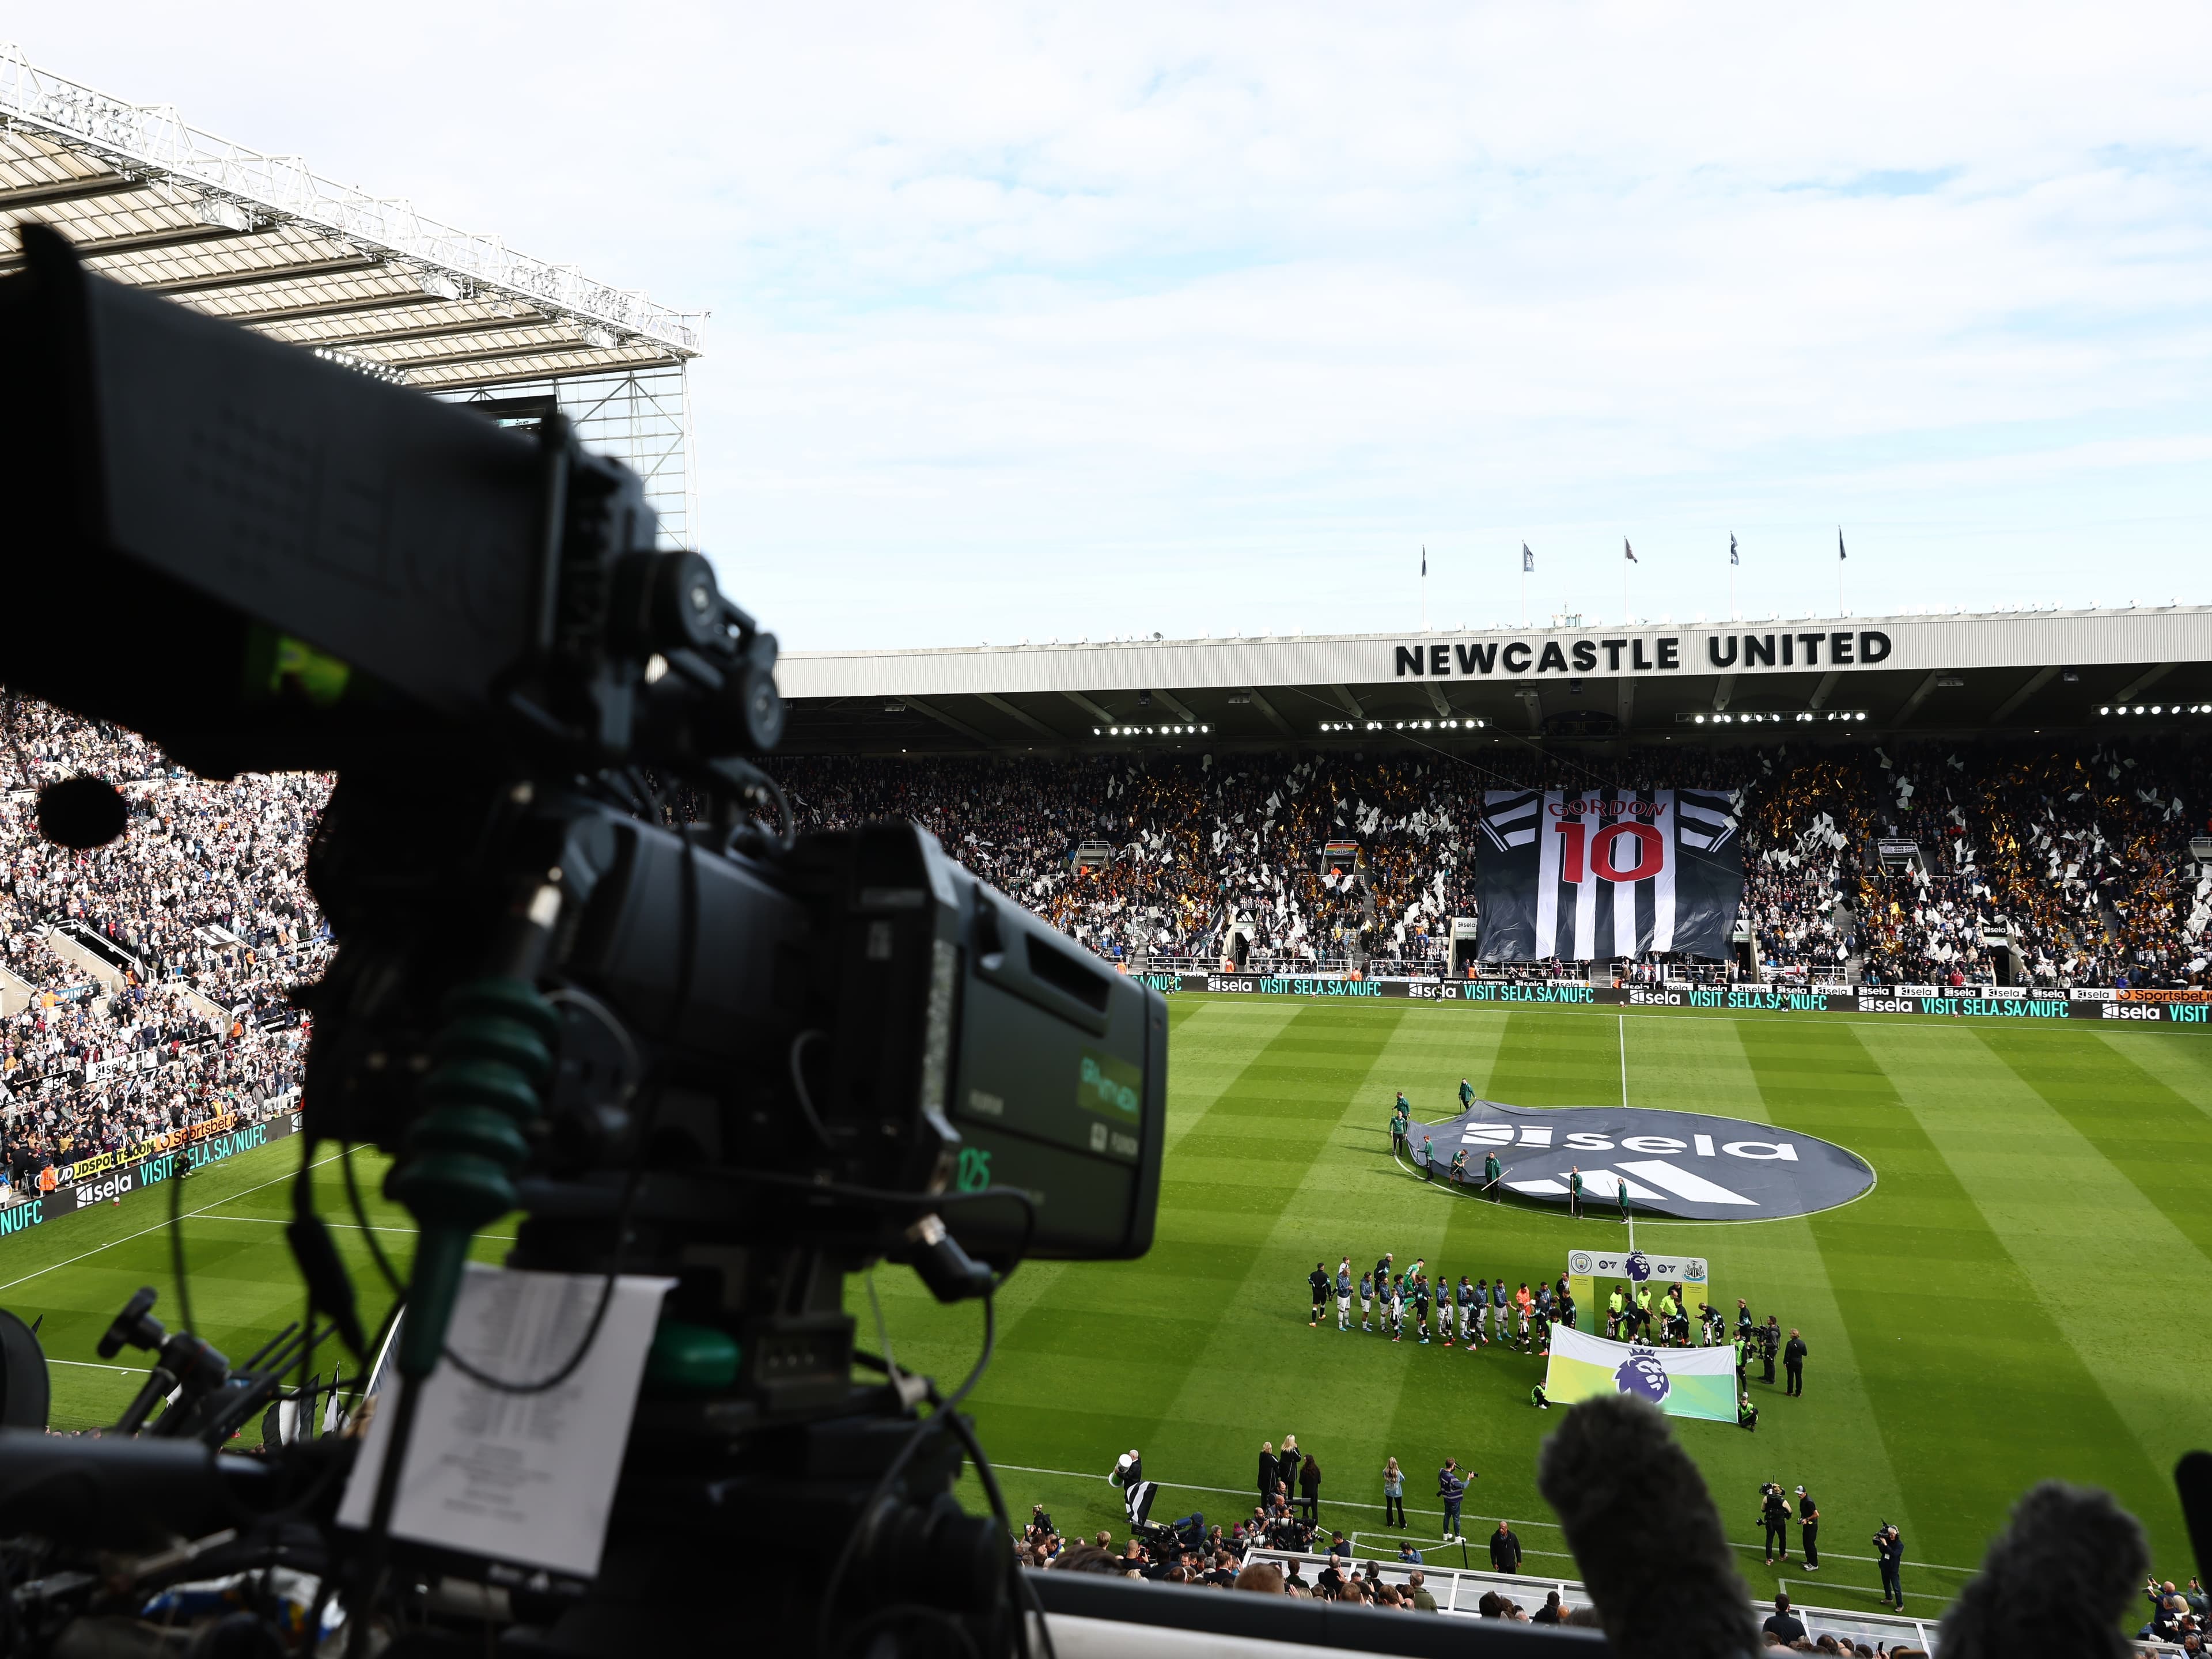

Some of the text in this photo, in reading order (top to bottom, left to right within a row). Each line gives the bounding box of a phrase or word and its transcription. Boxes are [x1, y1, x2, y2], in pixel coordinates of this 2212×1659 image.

[1396, 631, 1892, 676] NEWCASTLE UNITED
[1548, 798, 1667, 817] GORDON
[1555, 820, 1664, 884] 10
[1221, 979, 1252, 992] sela
[1259, 979, 1381, 996] VISIT SELA.SA/NUFC
[1464, 984, 1594, 1003] VISIT SELA.SA/NUFC
[1786, 986, 1807, 994] sela
[1827, 987, 1847, 995] sela
[1868, 987, 1889, 995] sela
[1911, 987, 1931, 996] sela
[1953, 988, 1976, 997] sela
[1998, 988, 2019, 997] sela
[2042, 988, 2065, 998] sela
[2087, 989, 2109, 999] sela
[1646, 990, 1680, 1005] sela
[1689, 990, 1723, 1007] VISIT
[1878, 997, 1912, 1013] sela
[1921, 997, 2069, 1018] VISIT SELA.SA/NUFC
[2120, 1004, 2160, 1020] sela
[2169, 1004, 2209, 1022] VISIT
[1563, 1131, 1799, 1161] sela
[77, 1141, 154, 1176] JDSPOTS.COM
[140, 1124, 267, 1187] VISIT ELA.SA/NUFC
[59, 1165, 74, 1182] JD
[94, 1174, 131, 1202] sela
[0, 1199, 43, 1237] NUFC
